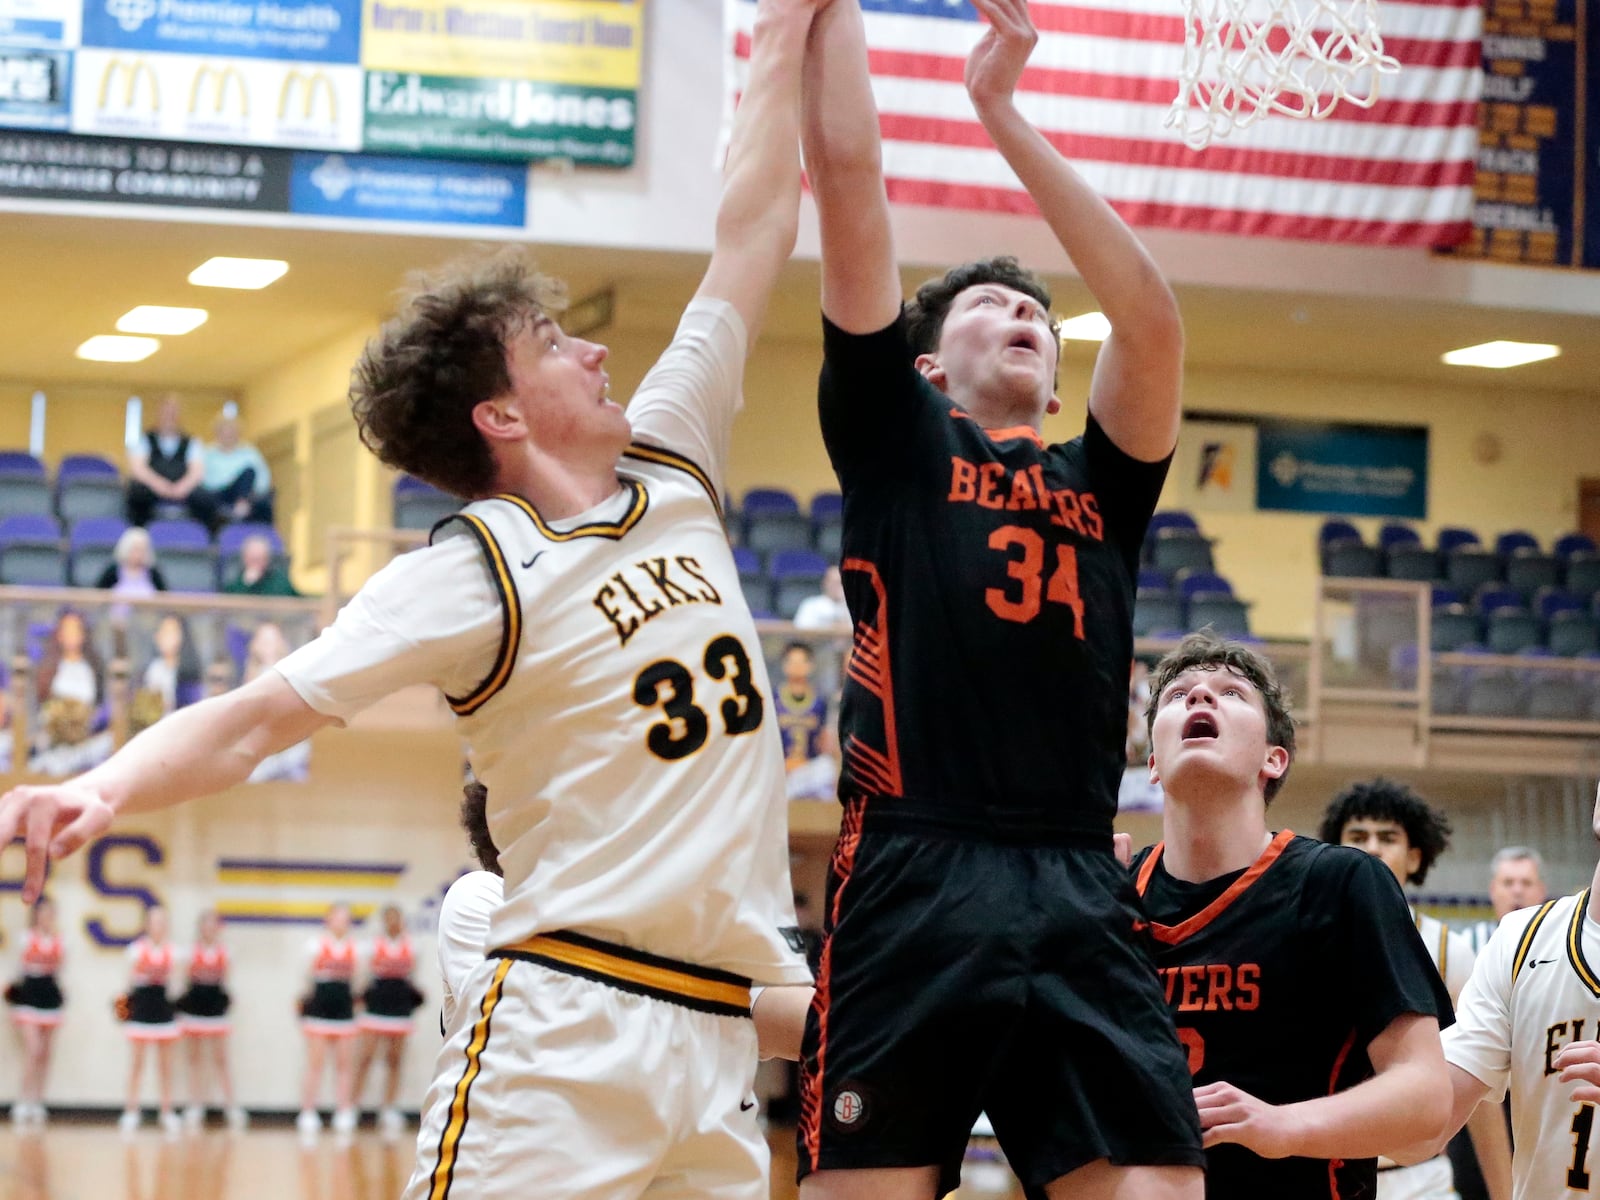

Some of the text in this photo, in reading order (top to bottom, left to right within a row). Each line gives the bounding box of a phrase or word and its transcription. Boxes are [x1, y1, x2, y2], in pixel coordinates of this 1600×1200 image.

[593, 555, 723, 648] ELKS
[985, 525, 1086, 640] 34
[631, 632, 765, 762] 33
